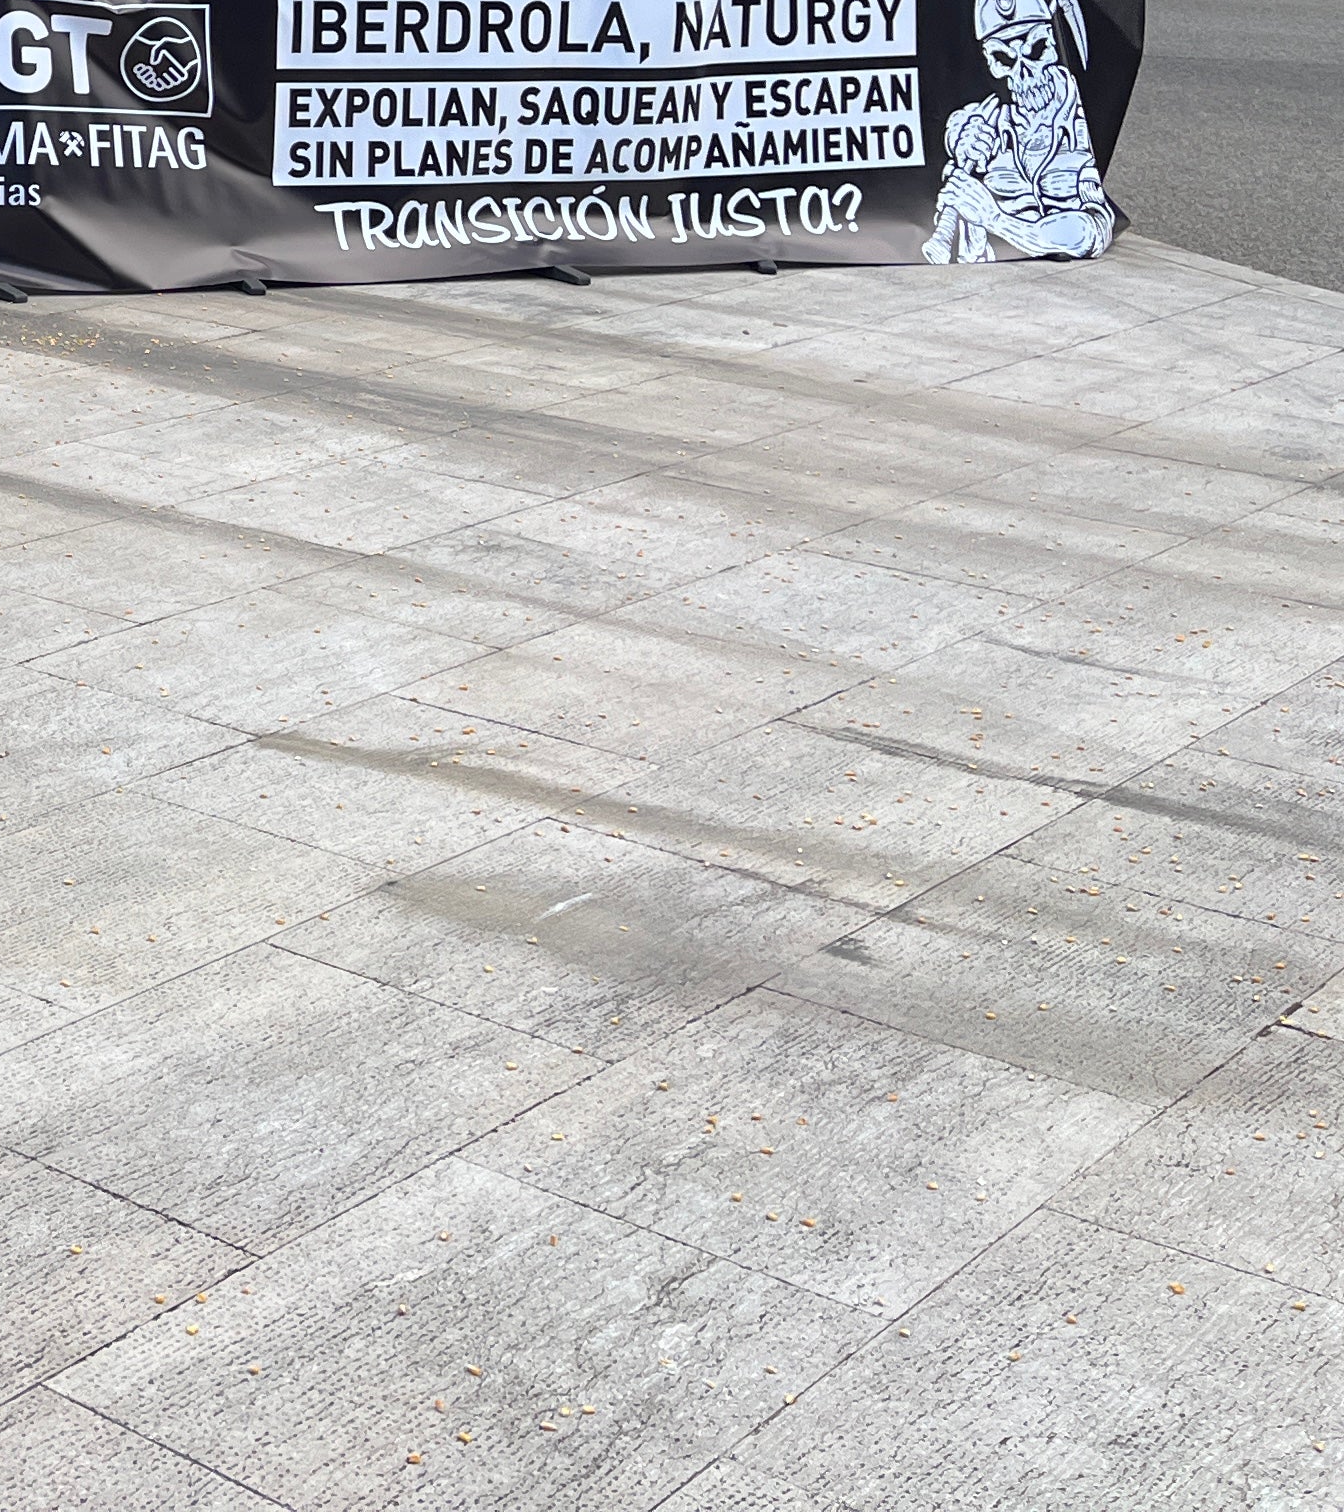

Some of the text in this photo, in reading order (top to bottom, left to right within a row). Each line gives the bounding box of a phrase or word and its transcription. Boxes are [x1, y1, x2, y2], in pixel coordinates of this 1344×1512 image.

[291, 0, 650, 64] IBERDROLA,
[288, 73, 914, 135] EXPOLIAN, SAQUEAN Y ESCAPAN
[88, 123, 208, 170] FITAG
[287, 120, 915, 180] SIN PLANES DE ACOMPAÑAMIENTO
